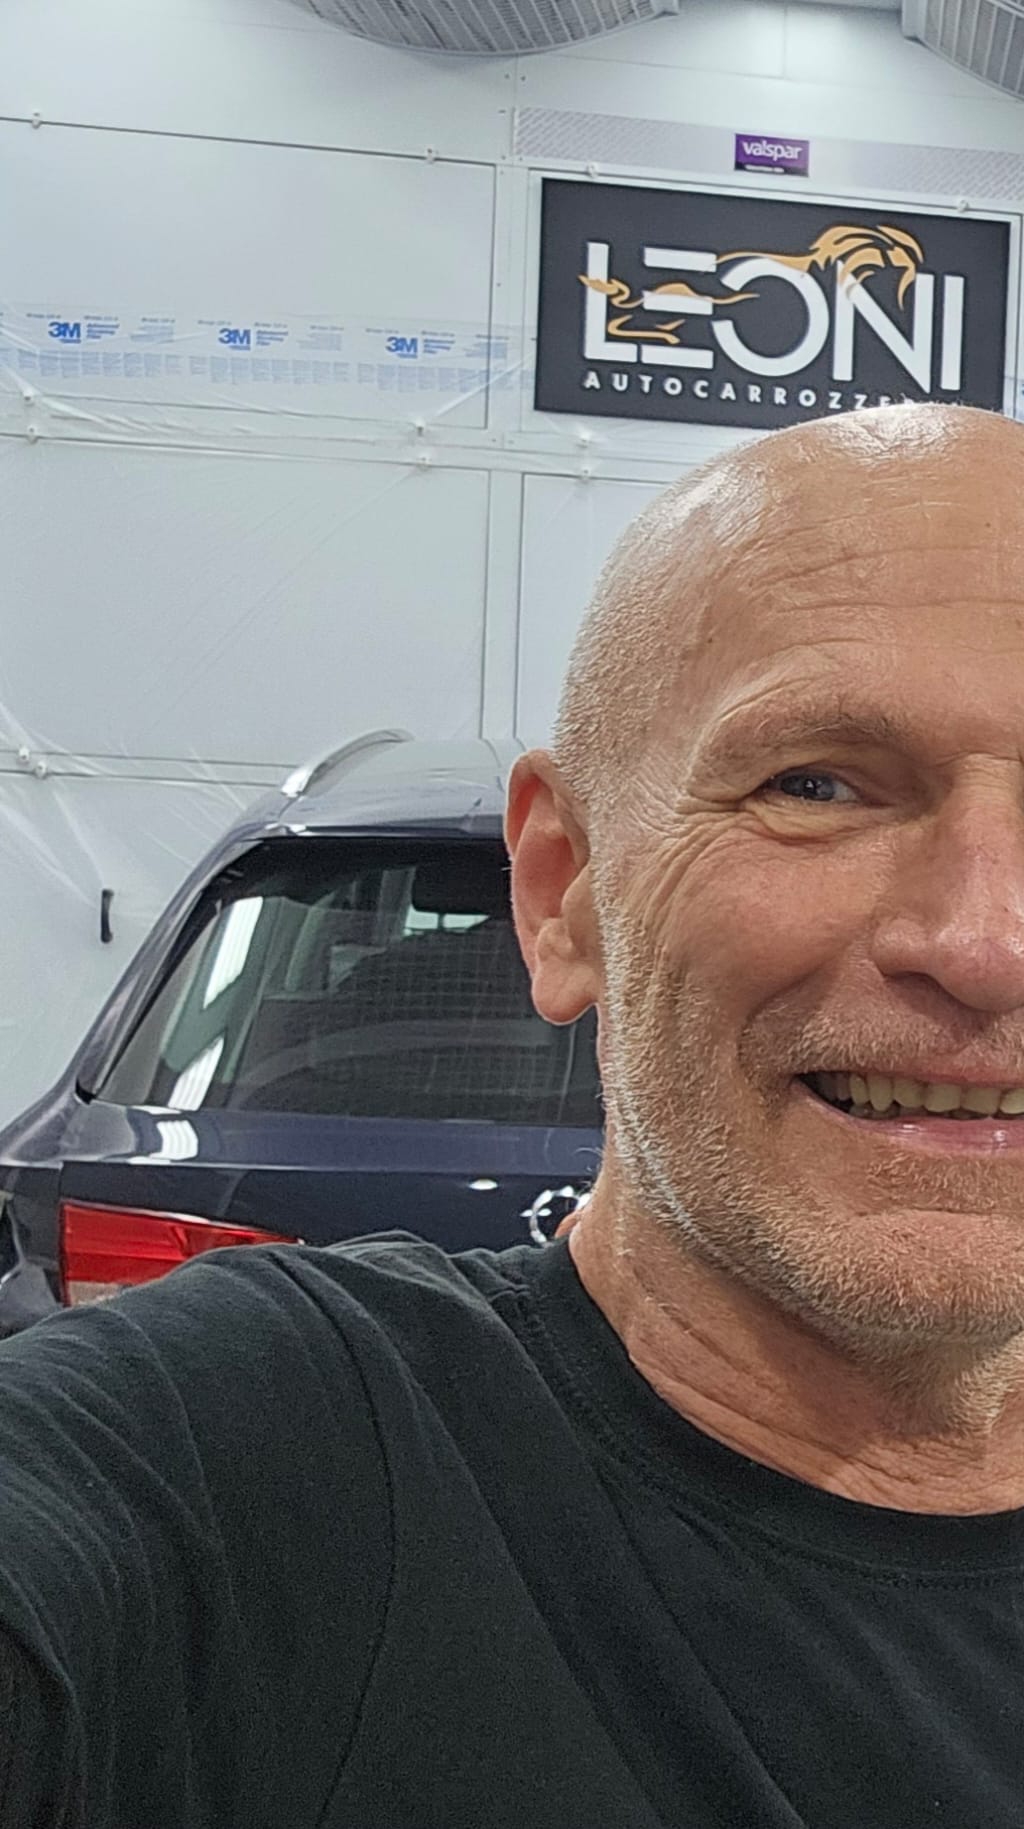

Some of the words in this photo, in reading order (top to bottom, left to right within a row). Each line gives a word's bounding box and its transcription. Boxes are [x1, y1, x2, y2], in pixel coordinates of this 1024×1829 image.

[742, 139, 803, 162] valspar
[582, 240, 965, 395] LEONI
[48, 321, 82, 339] 3M
[218, 328, 251, 345] 3M
[385, 336, 418, 353] 3M
[582, 371, 957, 410] AUTOCARROZZE
